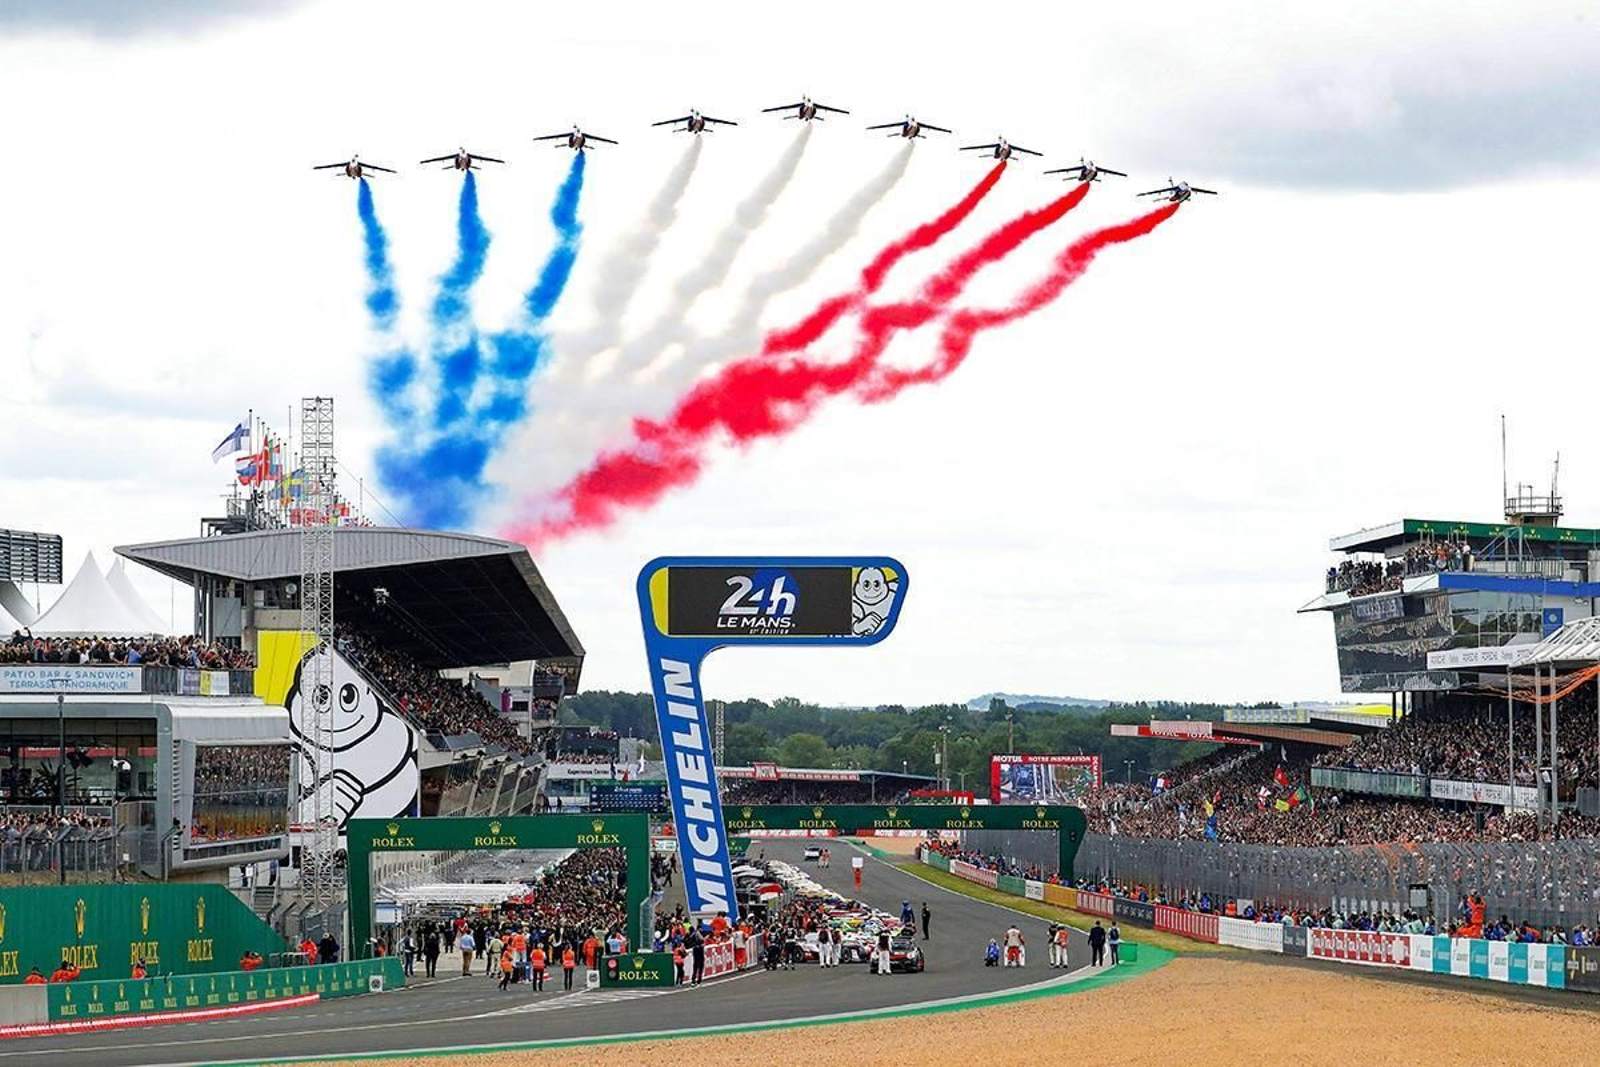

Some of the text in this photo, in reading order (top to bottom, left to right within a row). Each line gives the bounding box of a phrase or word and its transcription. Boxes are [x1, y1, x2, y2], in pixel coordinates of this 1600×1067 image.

[720, 575, 796, 615] 24h
[717, 617, 738, 628] LE
[4, 671, 36, 679] PATIO
[41, 671, 60, 679] BAR
[75, 671, 134, 679] SANDWICH
[10, 680, 129, 690] TERRASSE PANORAMIQUE
[992, 755, 1023, 763] MOTUL
[660, 658, 731, 925] MICHELIN
[728, 821, 766, 829] ROLEX
[800, 820, 837, 828] ROLEX
[874, 820, 911, 828] ROLEX
[946, 820, 984, 828] ROLEX
[1022, 820, 1060, 828] ROLEX
[372, 837, 414, 847] ROLEX
[475, 836, 517, 846] ROLEX
[577, 834, 620, 844] ROLEX
[131, 942, 159, 966] ROLEX
[188, 940, 213, 961] ROLEX
[62, 945, 98, 970] ROLEX
[619, 970, 659, 980] ROLEX
